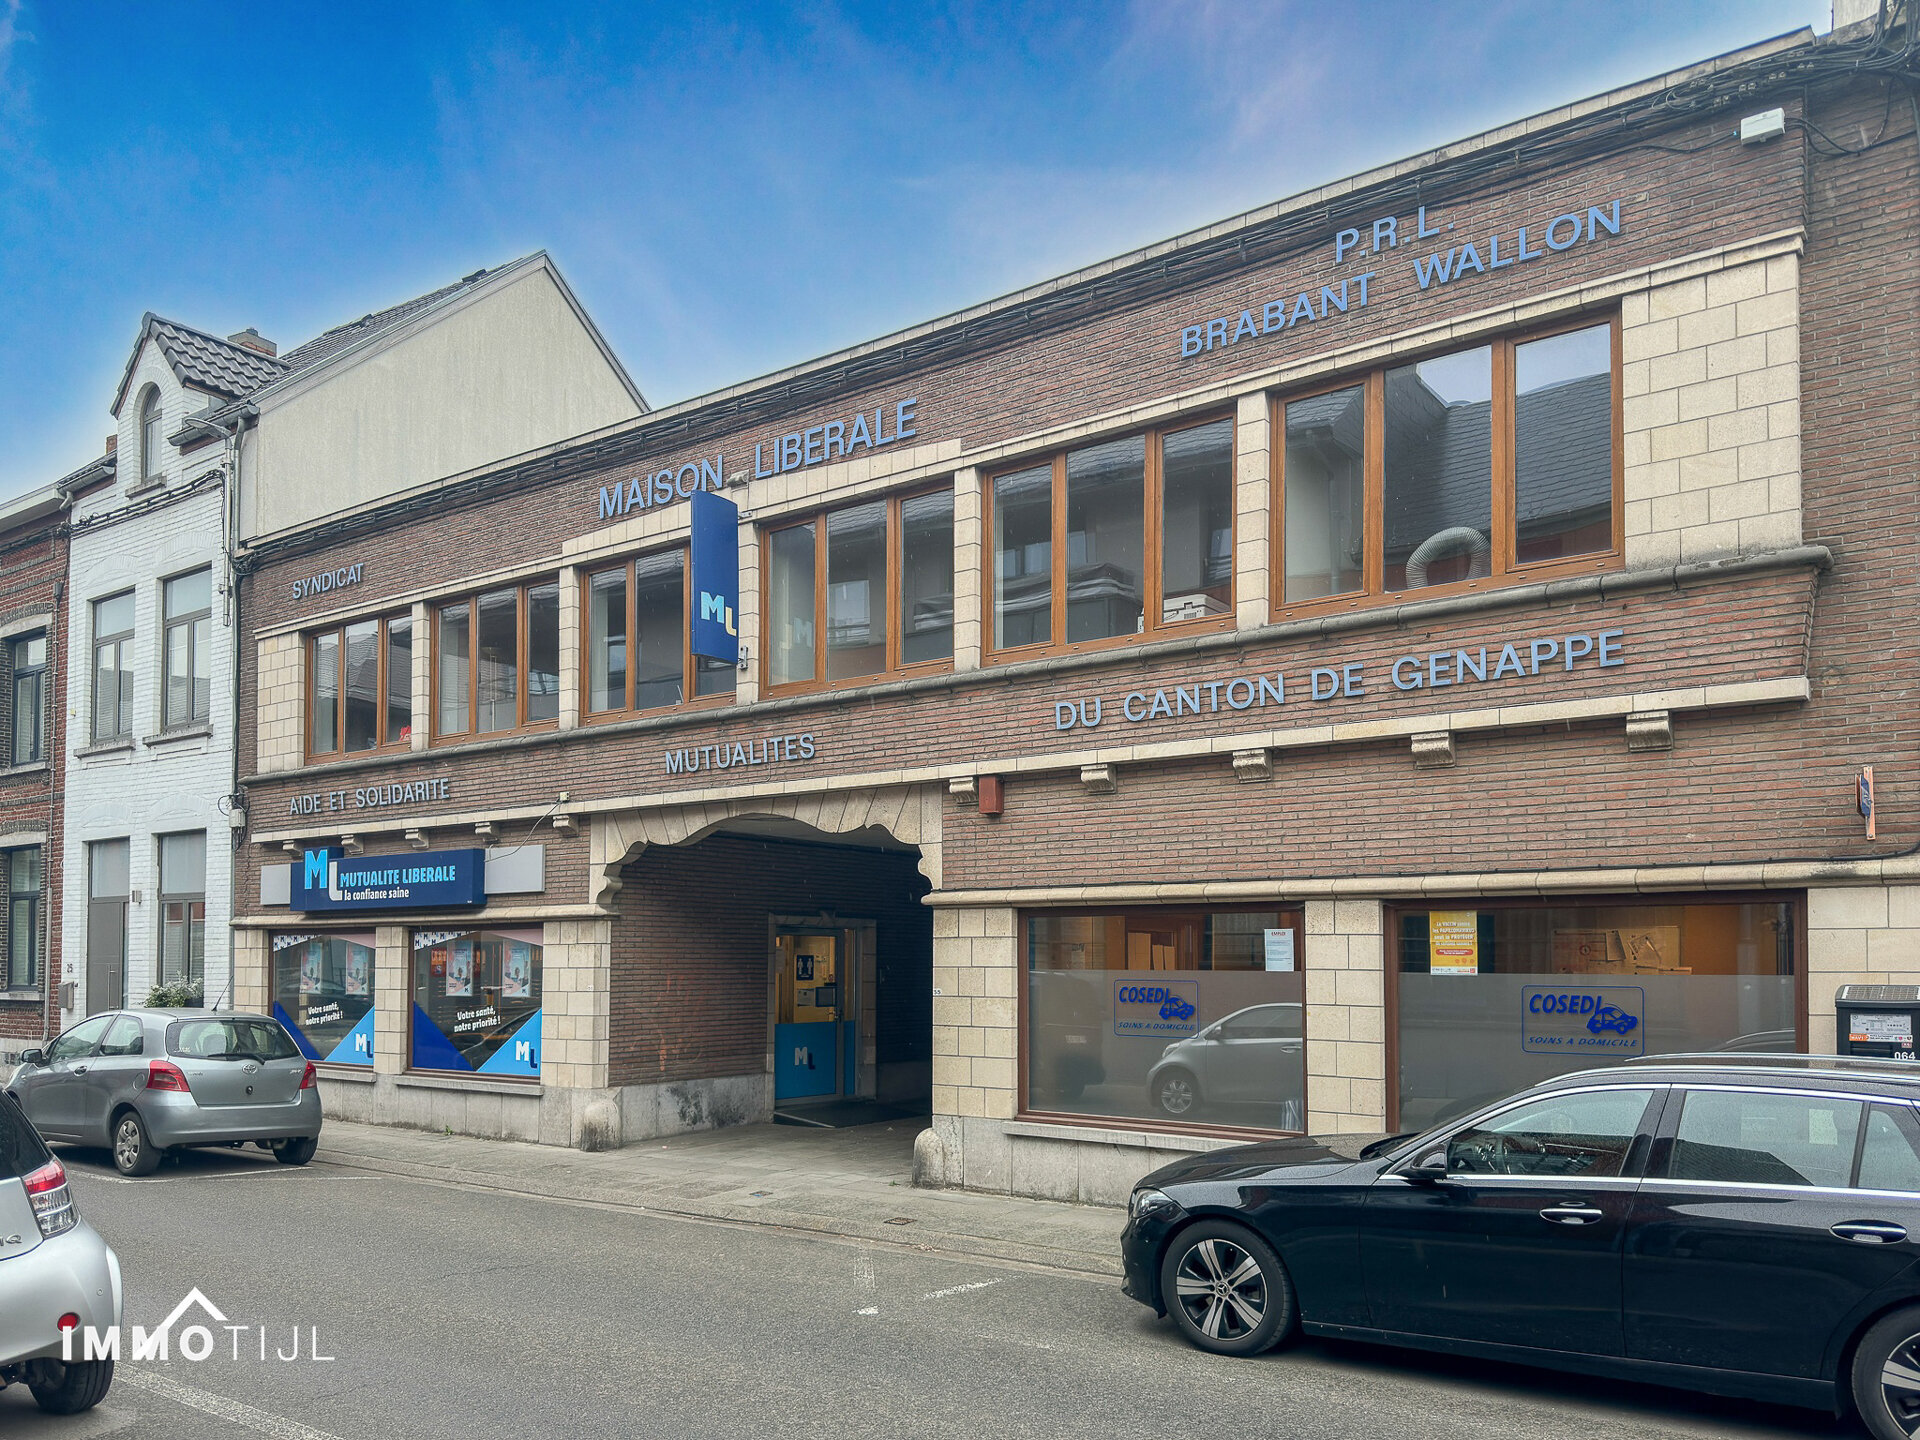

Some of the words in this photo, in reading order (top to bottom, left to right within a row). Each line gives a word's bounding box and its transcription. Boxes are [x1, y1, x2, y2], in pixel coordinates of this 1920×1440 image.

[1336, 205, 1454, 263] P.R.L.
[1181, 271, 1375, 357] BRABANT
[1413, 200, 1620, 289] WALLON
[600, 455, 723, 519] MAISON
[755, 398, 917, 479] LIBERALE
[292, 563, 364, 599] SYNDICAT
[1055, 696, 1102, 730] DU
[1123, 673, 1285, 722] CANTON
[1311, 663, 1365, 701] DE
[1391, 629, 1625, 690] GENAPPE
[665, 733, 815, 774] MUTUALITES
[290, 794, 322, 815] AIDE
[330, 790, 346, 811] ET
[355, 778, 450, 808] SOLIDARITE
[340, 869, 400, 888] MUTUALITE
[402, 865, 456, 884] LIBERALE
[344, 890, 352, 901] la
[353, 888, 387, 900] confiance
[388, 886, 410, 899] saine
[1119, 986, 1170, 1004] COSEDI
[1529, 993, 1602, 1014] COSEDI
[305, 1016, 320, 1026] notre
[320, 1011, 340, 1025] priorité
[307, 1005, 322, 1015] Votre
[457, 1011, 475, 1021] Votre
[475, 1005, 496, 1018] santé,
[454, 1022, 472, 1032] notre
[472, 1016, 497, 1031] priorité
[1153, 1023, 1196, 1031] DOMICILE
[1528, 1036, 1562, 1045] SOINS
[1578, 1038, 1640, 1047] DOMICILE
[1894, 1051, 1916, 1061] 064
